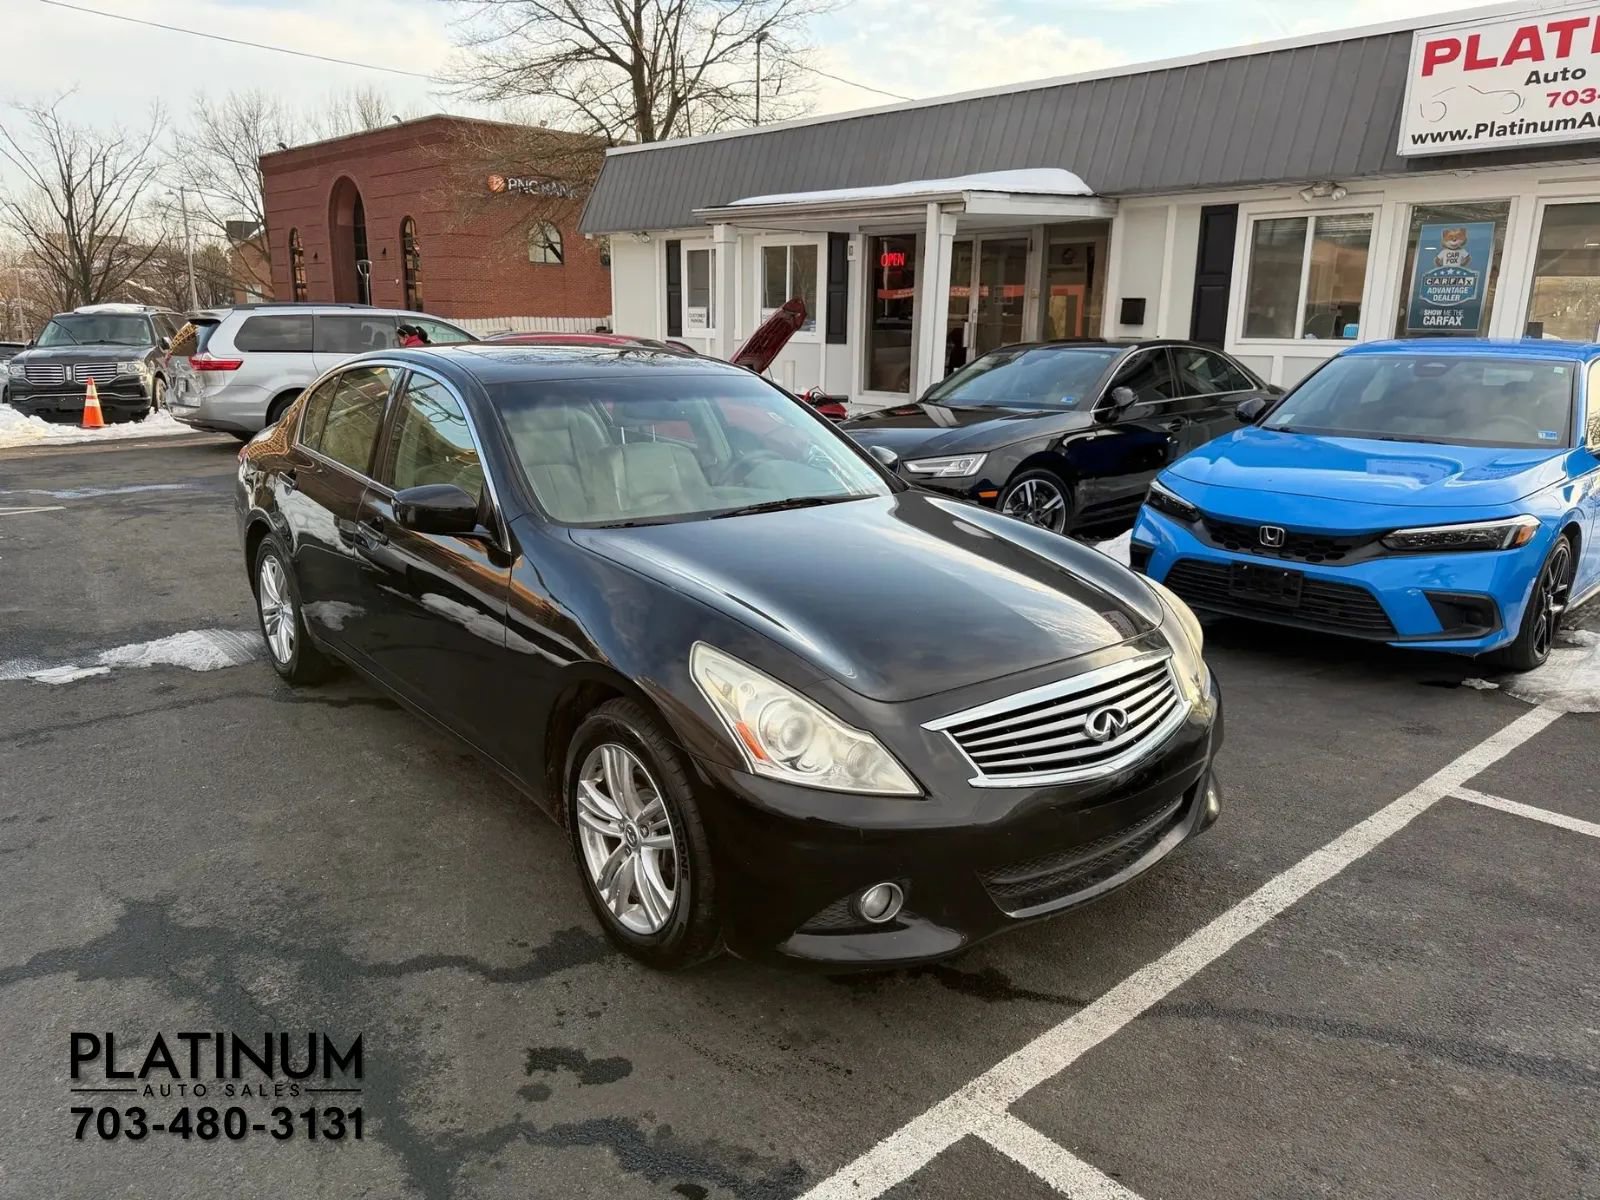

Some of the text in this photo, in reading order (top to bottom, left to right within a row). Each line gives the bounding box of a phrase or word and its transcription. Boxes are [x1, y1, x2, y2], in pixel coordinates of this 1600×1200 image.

[1524, 67, 1587, 86] Auto
[1411, 111, 1600, 145] www.PlatinumA
[880, 252, 905, 267] OPEN
[1426, 278, 1473, 286] CARFAX
[1426, 286, 1469, 294] ADVANTAGE
[1423, 316, 1462, 326] CARFAX
